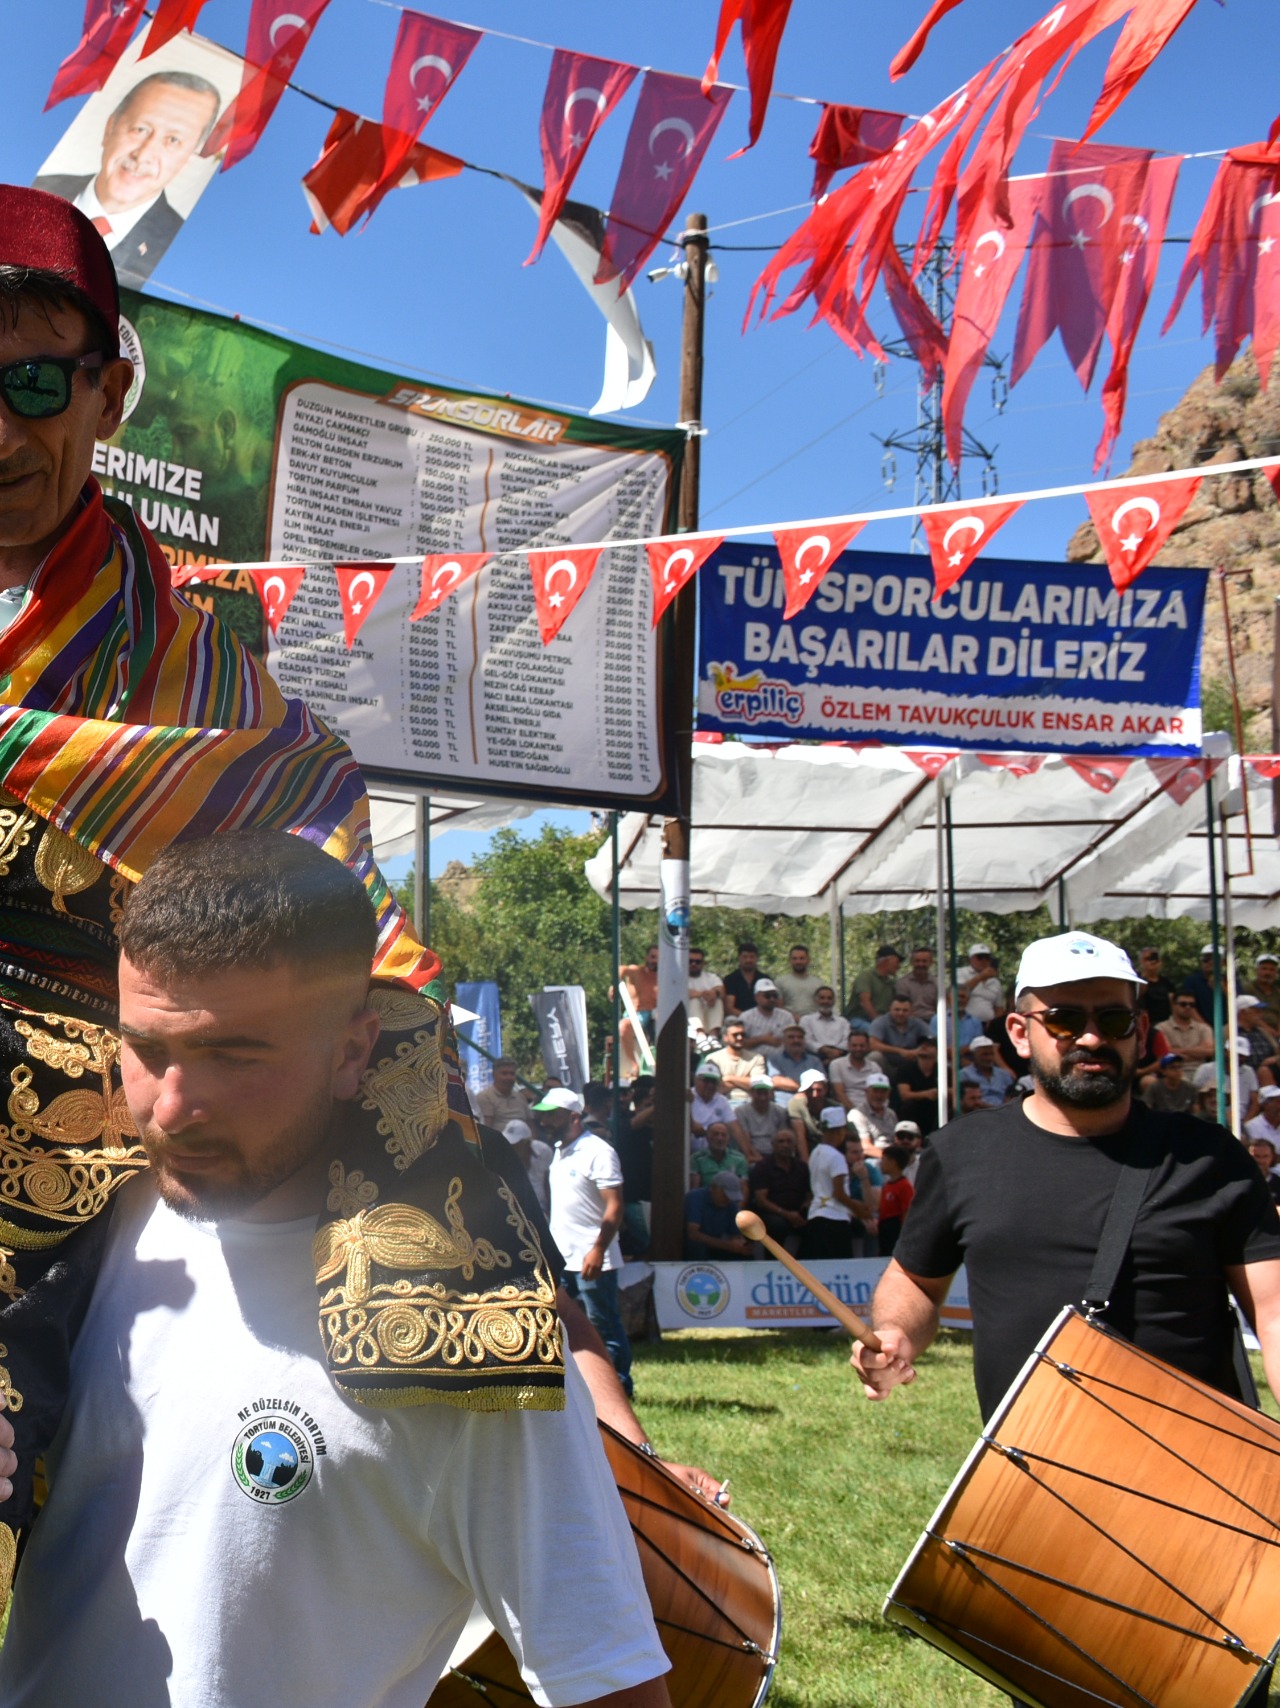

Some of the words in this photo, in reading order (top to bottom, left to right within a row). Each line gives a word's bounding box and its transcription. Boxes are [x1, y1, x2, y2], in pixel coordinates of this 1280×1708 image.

[335, 410, 386, 429] MARKETLER
[389, 423, 417, 437] GRUBU
[429, 434, 461, 448] 250.000
[464, 442, 473, 451] TL
[325, 443, 360, 459] GARDEN
[363, 453, 403, 469] ERZURUM
[426, 445, 461, 459] 200.000
[463, 454, 473, 462] TL
[323, 456, 352, 469] BETON
[425, 456, 460, 470] 200.000
[462, 465, 470, 473] TL
[91, 441, 202, 500] ERİMİZE
[289, 460, 317, 473] DAVUT
[320, 467, 378, 487] KUYUMCULUK
[289, 472, 323, 487] TORTUM
[459, 476, 469, 484] TL
[458, 487, 468, 496] TL
[286, 495, 321, 510] TORTUM
[324, 505, 353, 518] MADEN
[343, 497, 372, 510] EMRAH
[375, 504, 402, 516] YAVUZ
[459, 498, 469, 506] TL
[105, 488, 219, 546] UNAN
[285, 507, 313, 521] KAYEN
[315, 515, 337, 527] ALFA
[455, 520, 464, 528] TL
[454, 532, 463, 540] TL
[283, 531, 306, 543] OPEL
[362, 549, 392, 559] GROUP
[638, 578, 648, 586] TL
[639, 589, 648, 598] TL
[308, 596, 339, 608] GROUP
[816, 570, 1187, 629] SPORCULARIMIZA
[638, 622, 647, 631] TL
[447, 630, 455, 638] TL
[447, 641, 456, 649] TL
[637, 644, 646, 652] TL
[447, 652, 456, 660] TL
[743, 623, 978, 679] BAŞARILAR
[987, 628, 1146, 681] DİLERİZ
[447, 663, 457, 671] TL
[637, 677, 646, 685] TL
[444, 697, 454, 706] TL
[721, 688, 800, 719] erpiliç
[445, 709, 454, 717] TL
[637, 710, 646, 718] TL
[820, 694, 891, 722] ÖZLEM
[897, 703, 1034, 732] TAVUKÇULUK
[1042, 708, 1114, 731] ENSAR
[1120, 714, 1183, 735] AKAR
[446, 720, 455, 729] TL
[447, 731, 456, 740] TL
[638, 731, 647, 740] TL
[448, 742, 457, 751] TL
[449, 754, 459, 763] TL
[639, 753, 649, 761] TL
[640, 764, 650, 773] TL
[237, 1406, 251, 1422] NE
[252, 1398, 301, 1416] GÜZELSİN
[300, 1412, 327, 1456] TORTUM
[244, 1421, 276, 1440] TORTUM
[279, 1422, 311, 1464] BELEDİYESİ
[250, 1486, 270, 1500] 1927
